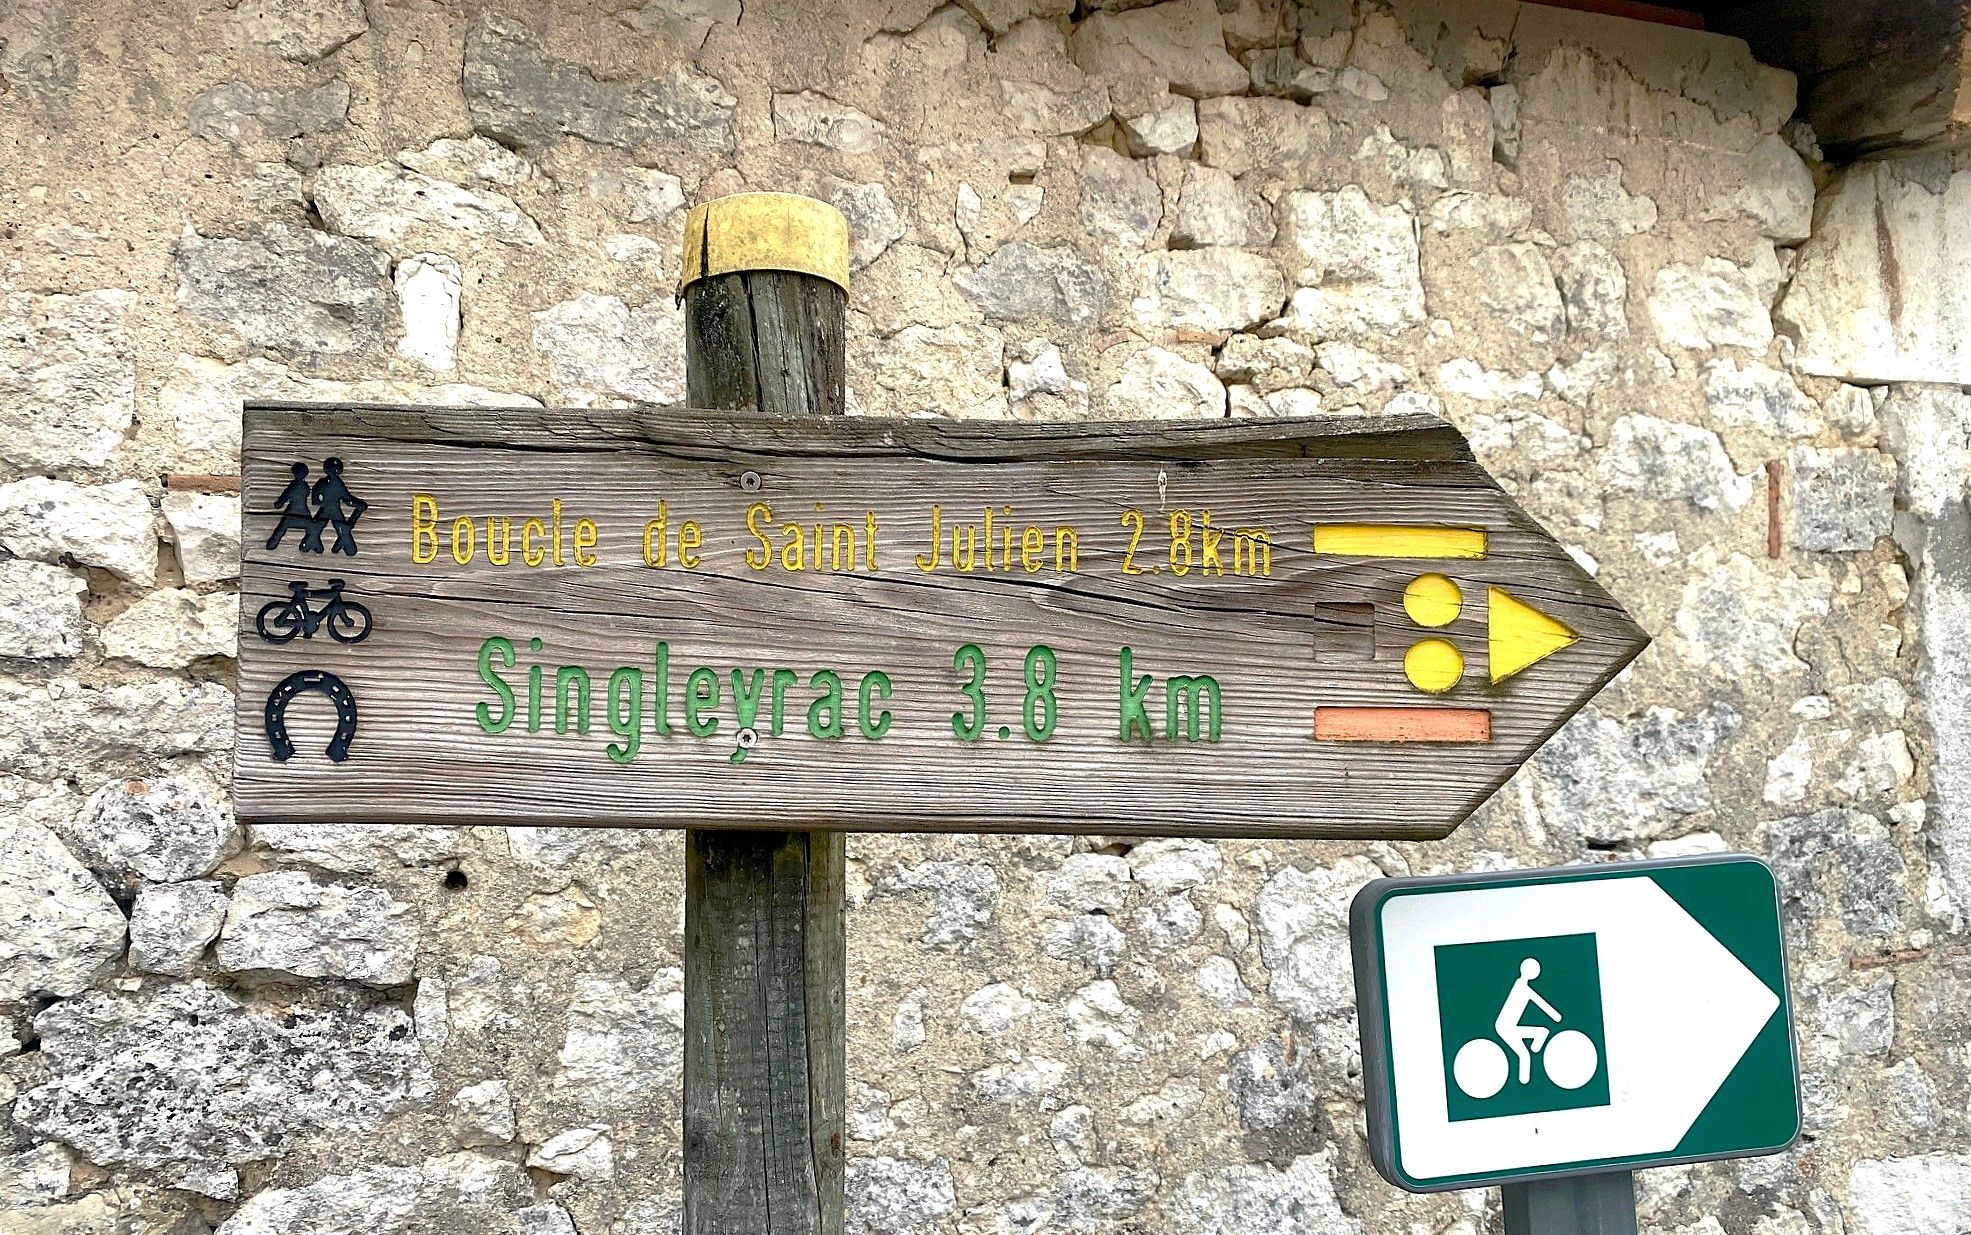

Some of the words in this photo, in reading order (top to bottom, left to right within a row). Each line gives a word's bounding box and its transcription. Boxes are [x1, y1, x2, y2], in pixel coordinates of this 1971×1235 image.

[410, 493, 598, 568] Boucle
[641, 500, 703, 569] de
[744, 501, 879, 573] Saint
[914, 504, 1079, 575] Julien
[1120, 508, 1273, 577] 2.8km
[474, 635, 894, 765] Singleyrac
[951, 641, 1060, 743] 3.8
[1118, 645, 1224, 744] km
